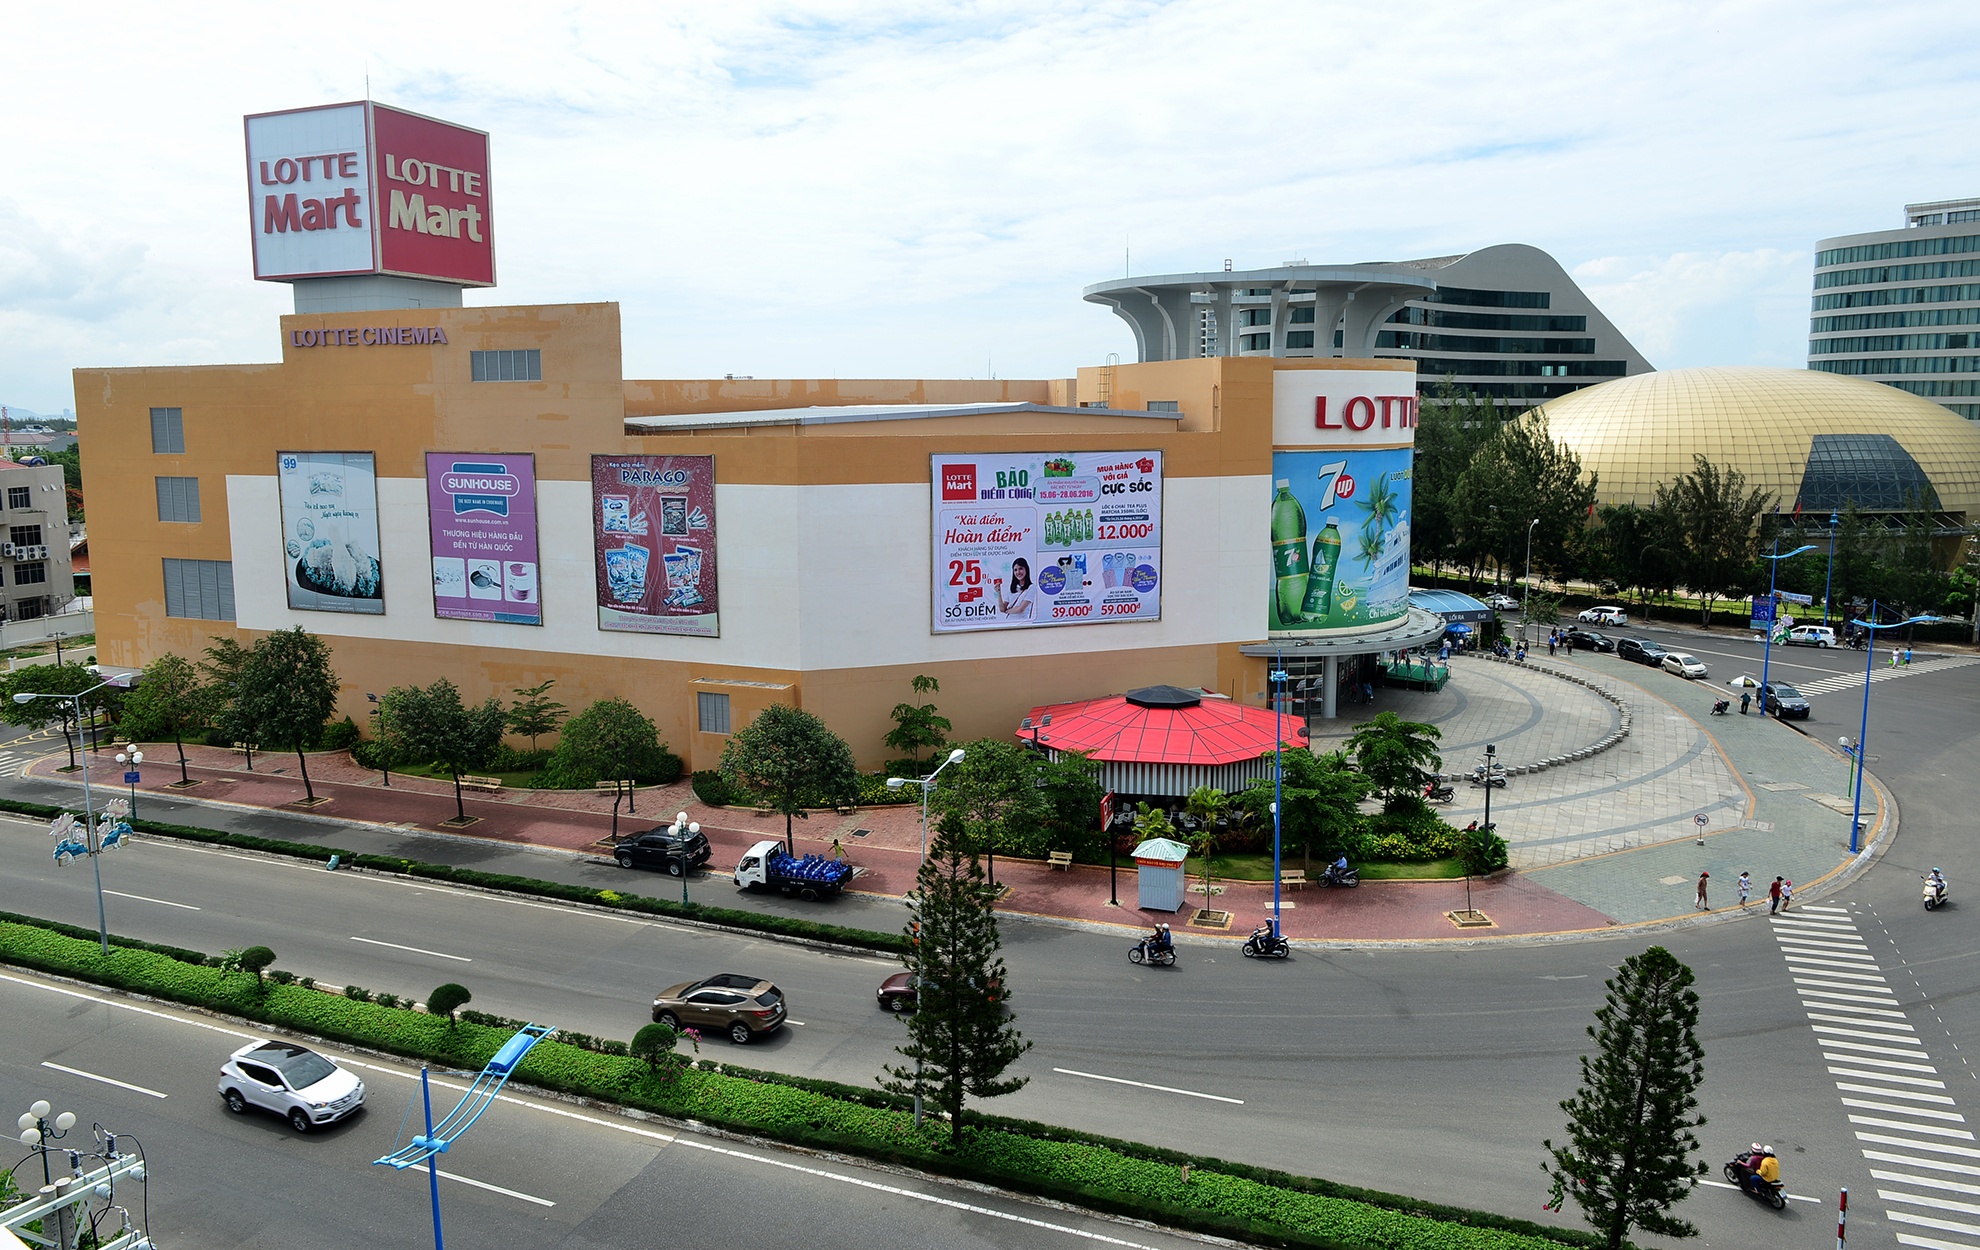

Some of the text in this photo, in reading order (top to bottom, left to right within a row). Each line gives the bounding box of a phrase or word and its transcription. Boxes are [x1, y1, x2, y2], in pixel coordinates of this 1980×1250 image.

[260, 152, 358, 185] LOTTE
[385, 153, 482, 197] LOTTE
[264, 188, 362, 234] Mart
[389, 189, 483, 242] Mart
[290, 326, 448, 347] LOTTE CINEMA
[1114, 462, 1134, 470] HÀNG
[448, 478, 512, 491] SUNHOUSE
[622, 470, 687, 484] PARAGO
[996, 467, 1028, 488] BÃO
[1103, 471, 1129, 481] VỚI GIÁ
[946, 481, 973, 490] Mart
[1102, 477, 1153, 497] CỰC SỐC
[979, 511, 1005, 525] điểm
[944, 527, 984, 545] Hoàn
[945, 602, 997, 618] SỐ ĐIỂM
